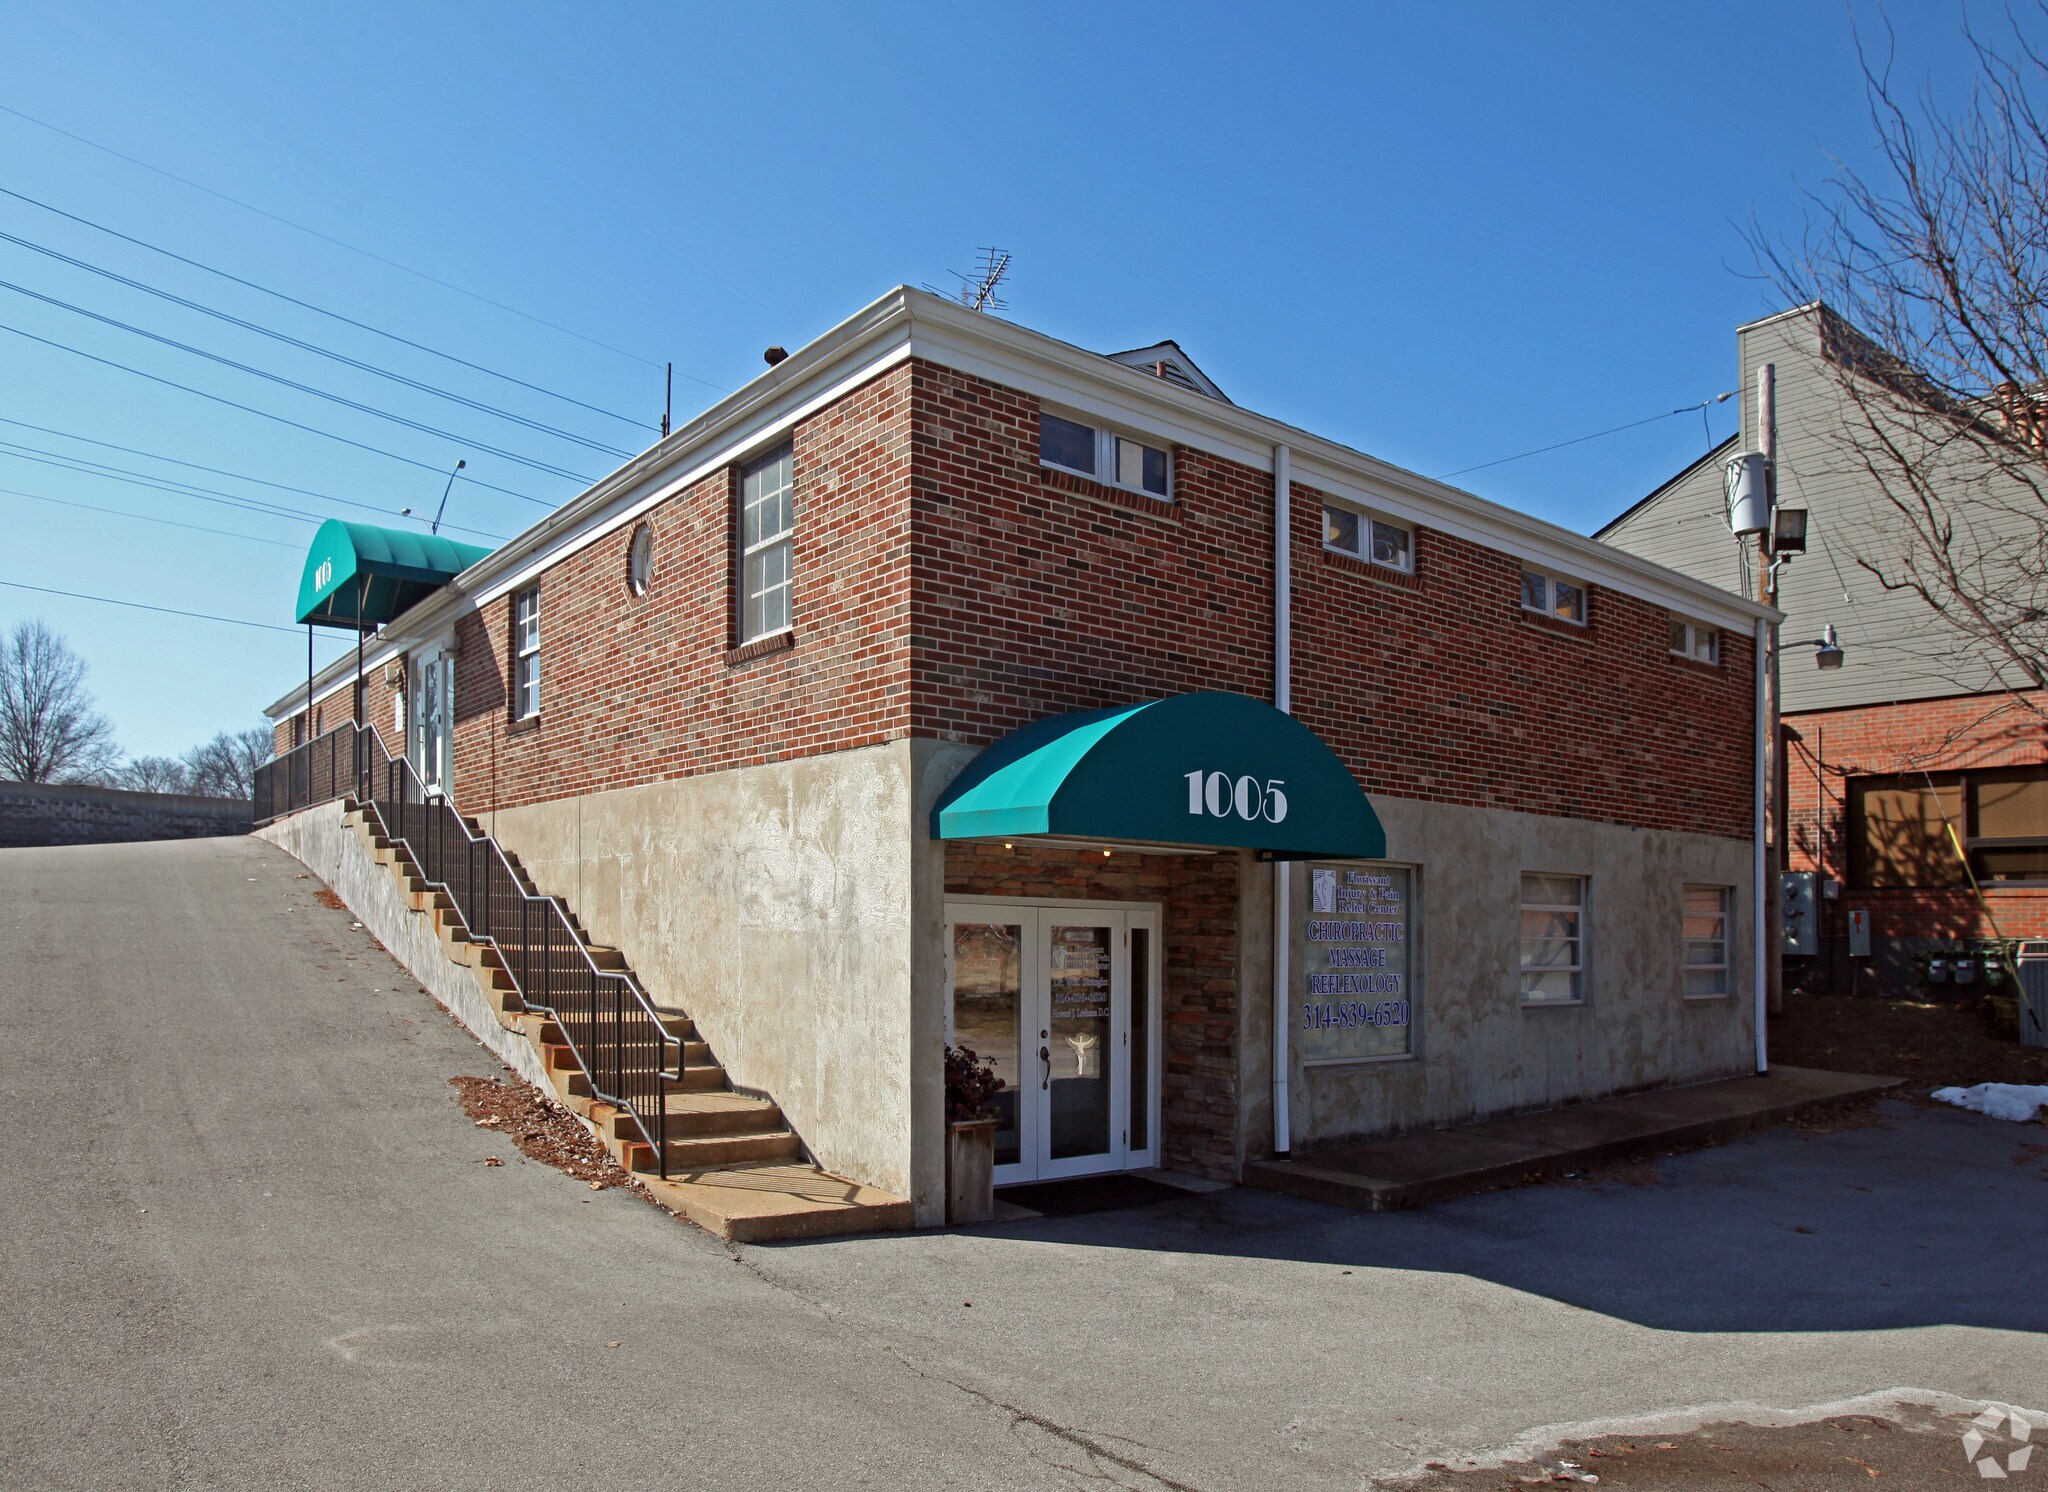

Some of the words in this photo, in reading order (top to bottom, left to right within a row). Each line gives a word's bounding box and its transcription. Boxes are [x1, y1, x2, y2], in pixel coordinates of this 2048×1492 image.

[1184, 770, 1288, 824] 1005
[1347, 871, 1390, 886] Florissant
[1338, 886, 1367, 901] Injury
[1369, 888, 1377, 899] &
[1379, 888, 1399, 900] Pain
[1338, 900, 1366, 914] Relief
[1368, 902, 1398, 914] Center
[1308, 920, 1404, 942] CHIROPRACTIC
[1328, 948, 1386, 968] MASSAGE
[1311, 974, 1402, 995] REFLEXOLOGY
[1304, 1000, 1409, 1030] 314-839-6520
